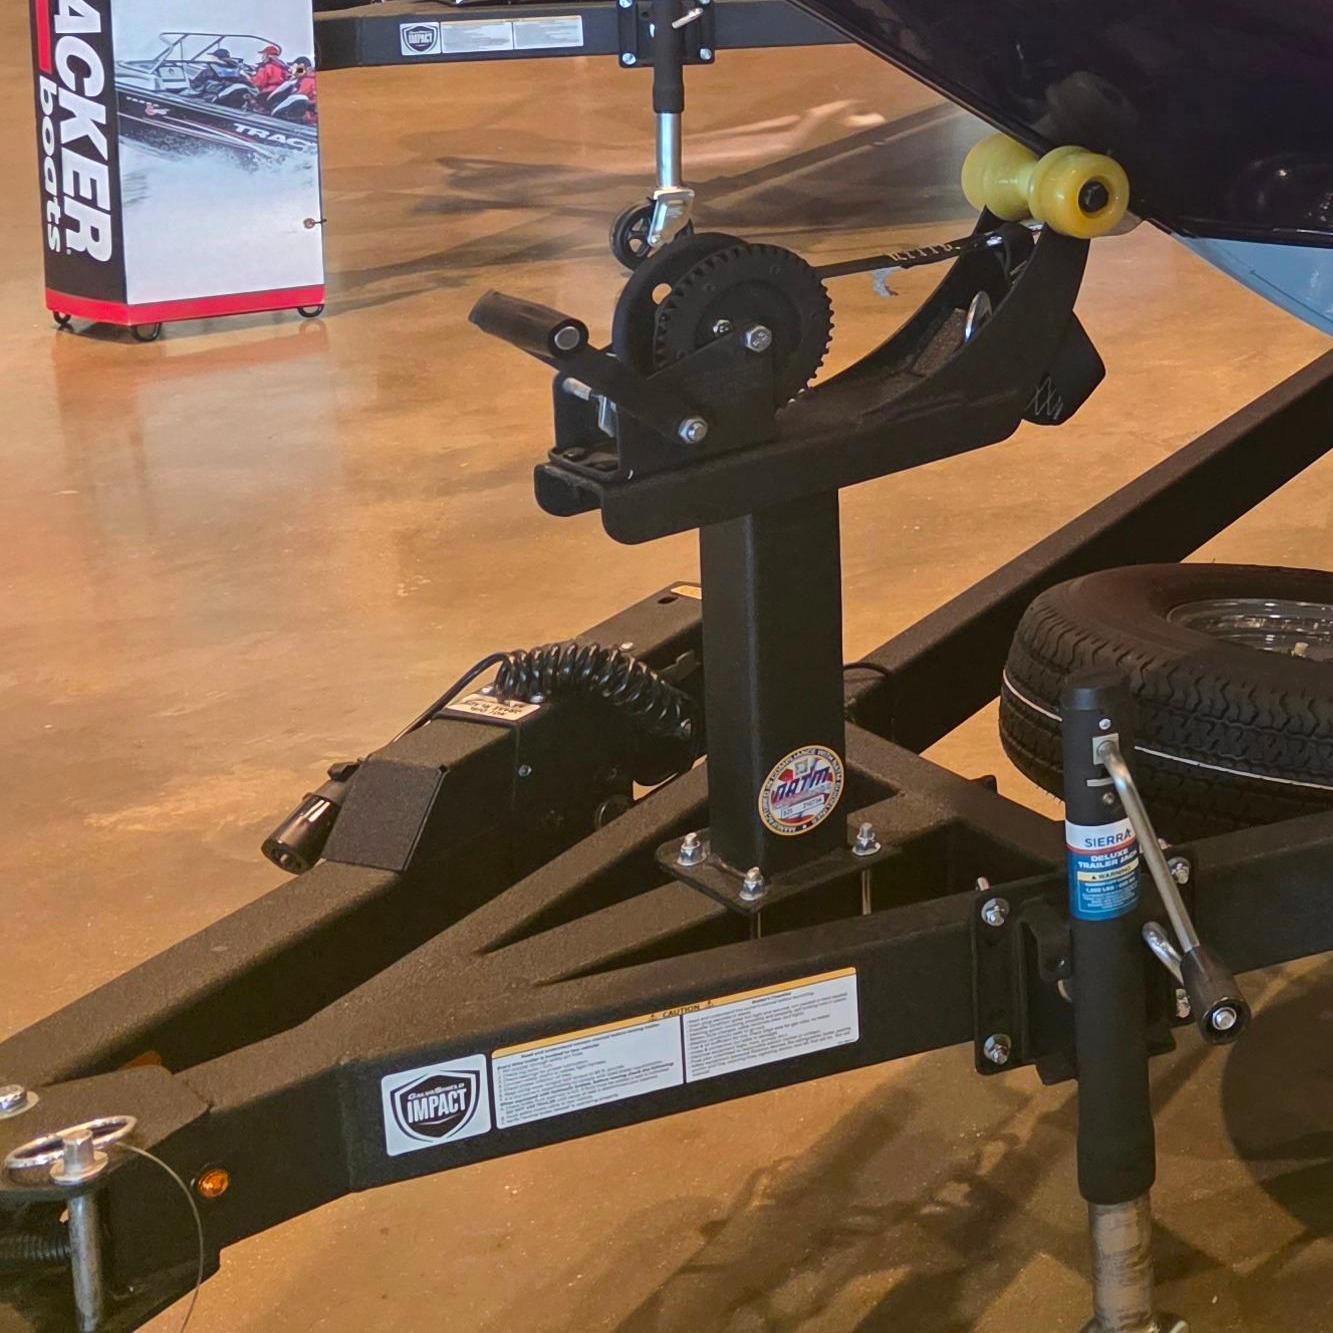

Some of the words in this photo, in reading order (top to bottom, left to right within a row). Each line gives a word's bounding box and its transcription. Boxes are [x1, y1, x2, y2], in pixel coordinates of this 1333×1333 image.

[36, 78, 61, 254] boats
[1084, 828, 1131, 848] SIERRA
[1078, 859, 1118, 869] TRAILER
[1090, 848, 1129, 862] DELUXE
[407, 1088, 467, 1123] IMPACT
